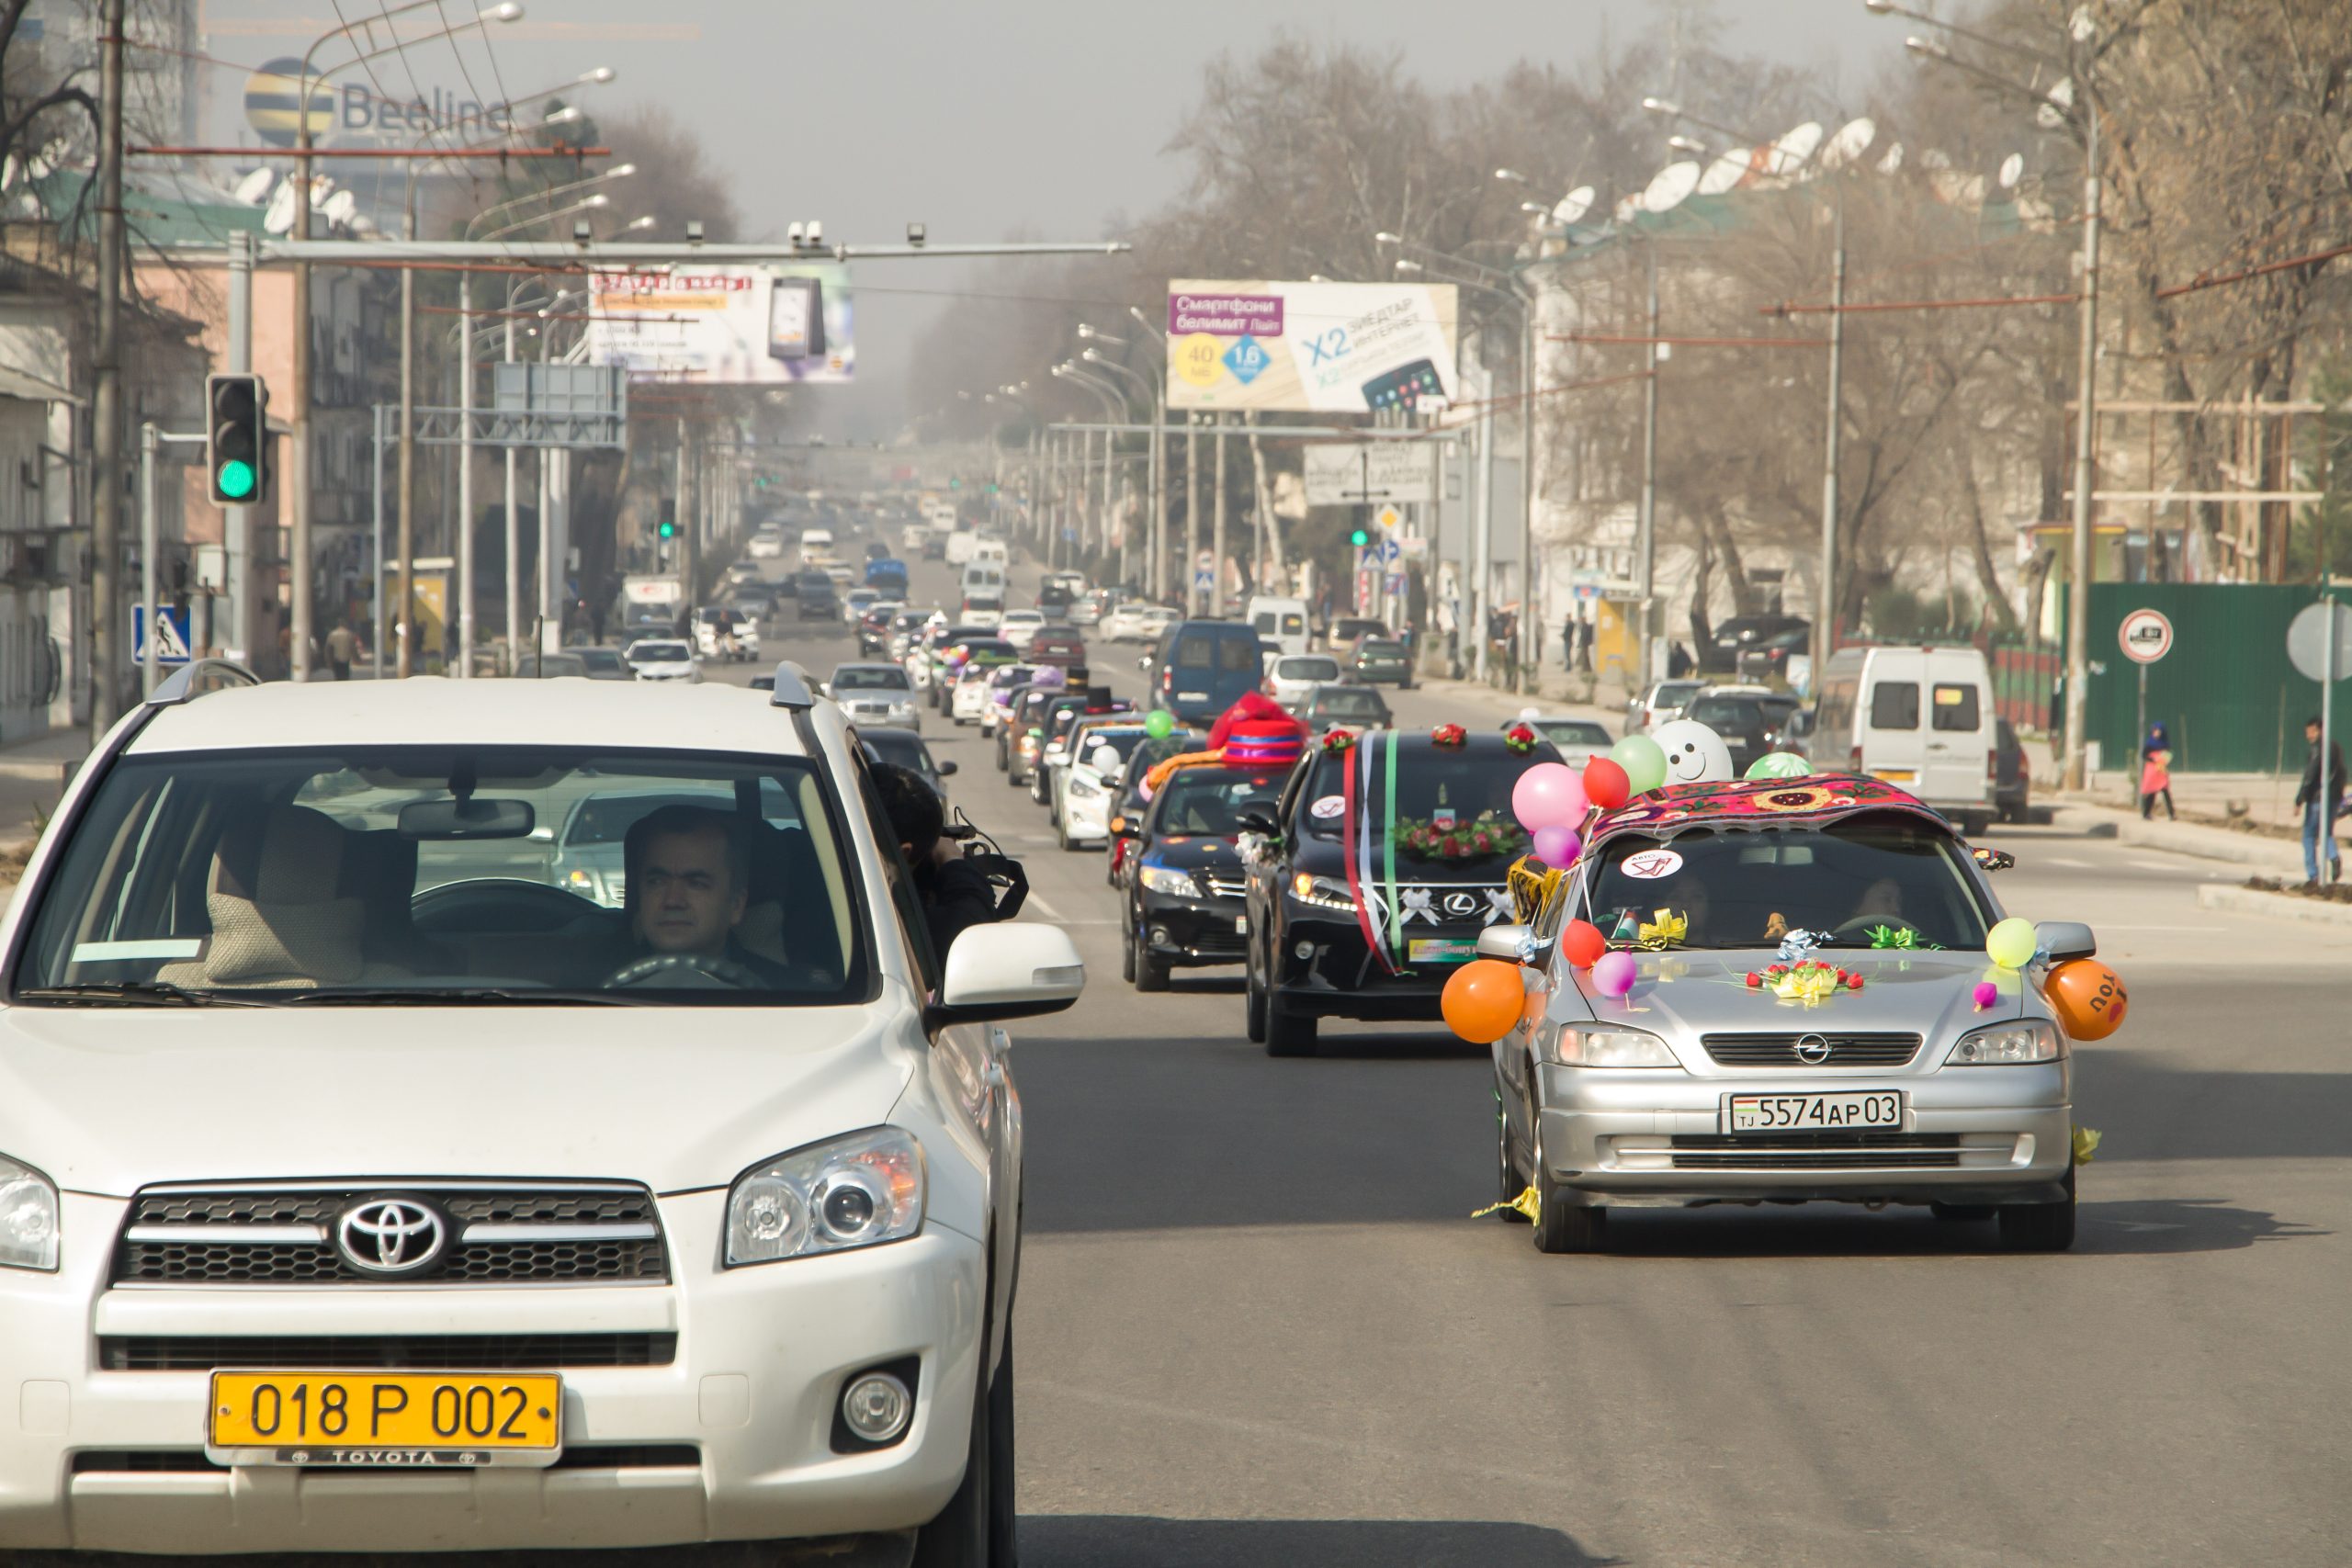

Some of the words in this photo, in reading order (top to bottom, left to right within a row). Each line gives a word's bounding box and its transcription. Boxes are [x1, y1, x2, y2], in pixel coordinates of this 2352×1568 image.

[344, 84, 510, 132] Beeline
[1188, 344, 1215, 363] 40
[2089, 974, 2115, 1012] YOU
[1740, 1116, 1754, 1127] TJ
[251, 1383, 348, 1437] 018
[371, 1383, 408, 1438] P
[432, 1385, 527, 1438] 002
[332, 1451, 436, 1464] TOYOTA
